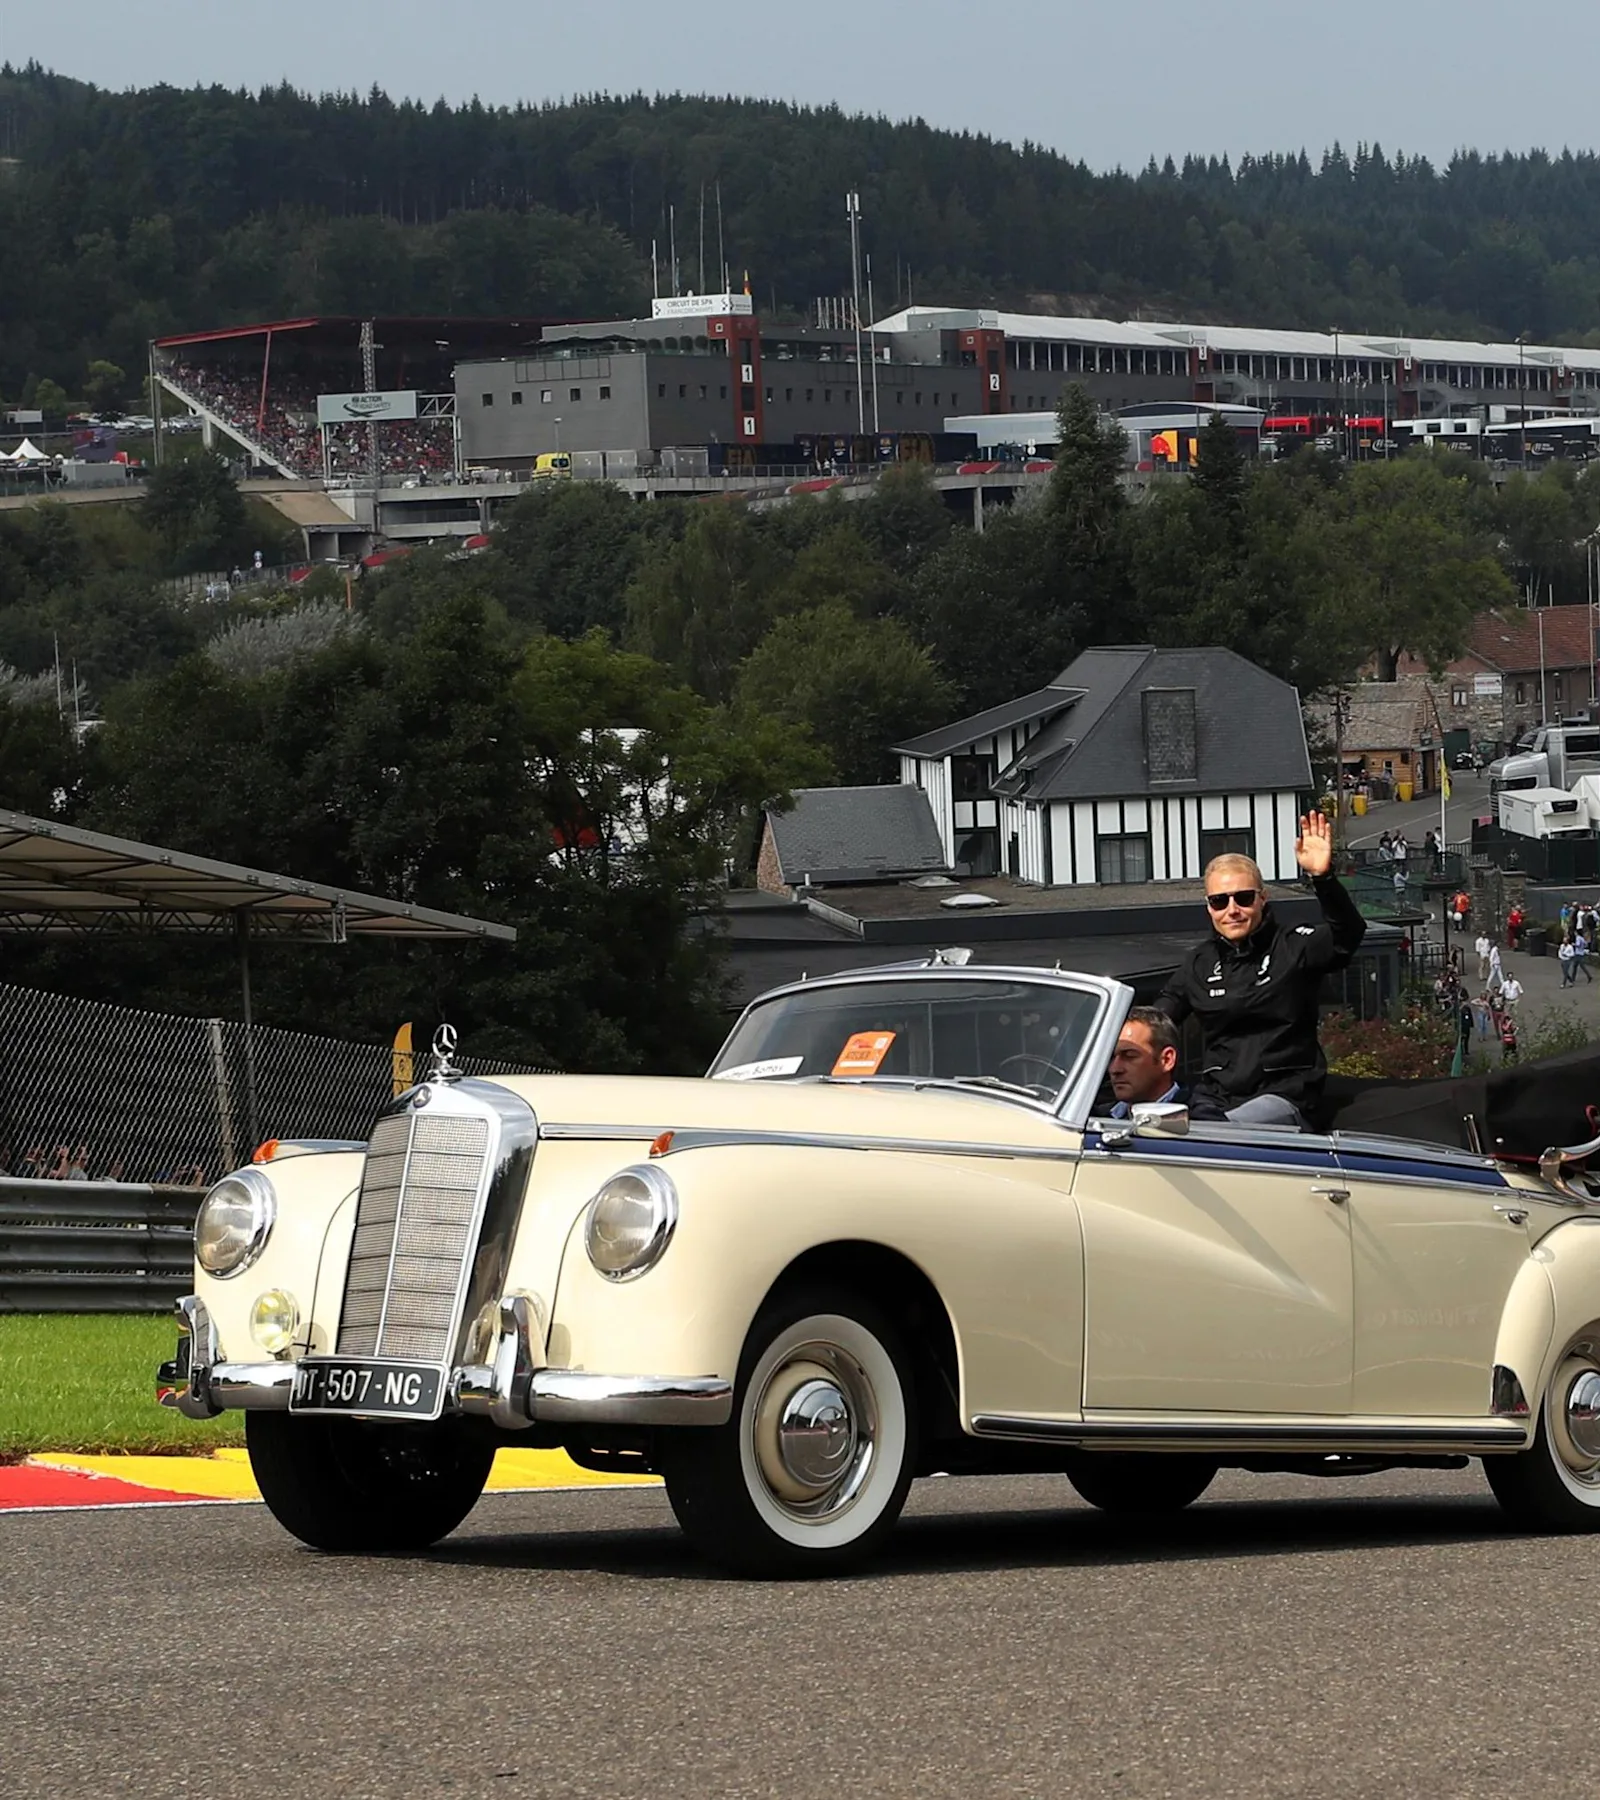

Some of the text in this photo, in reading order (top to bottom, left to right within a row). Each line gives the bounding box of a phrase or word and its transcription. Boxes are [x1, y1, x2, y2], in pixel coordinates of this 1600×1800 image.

[667, 300, 690, 308] CIRCUIT
[700, 298, 712, 306] SPA
[745, 366, 750, 380] 1
[992, 375, 998, 389] 2
[748, 419, 752, 433] 1
